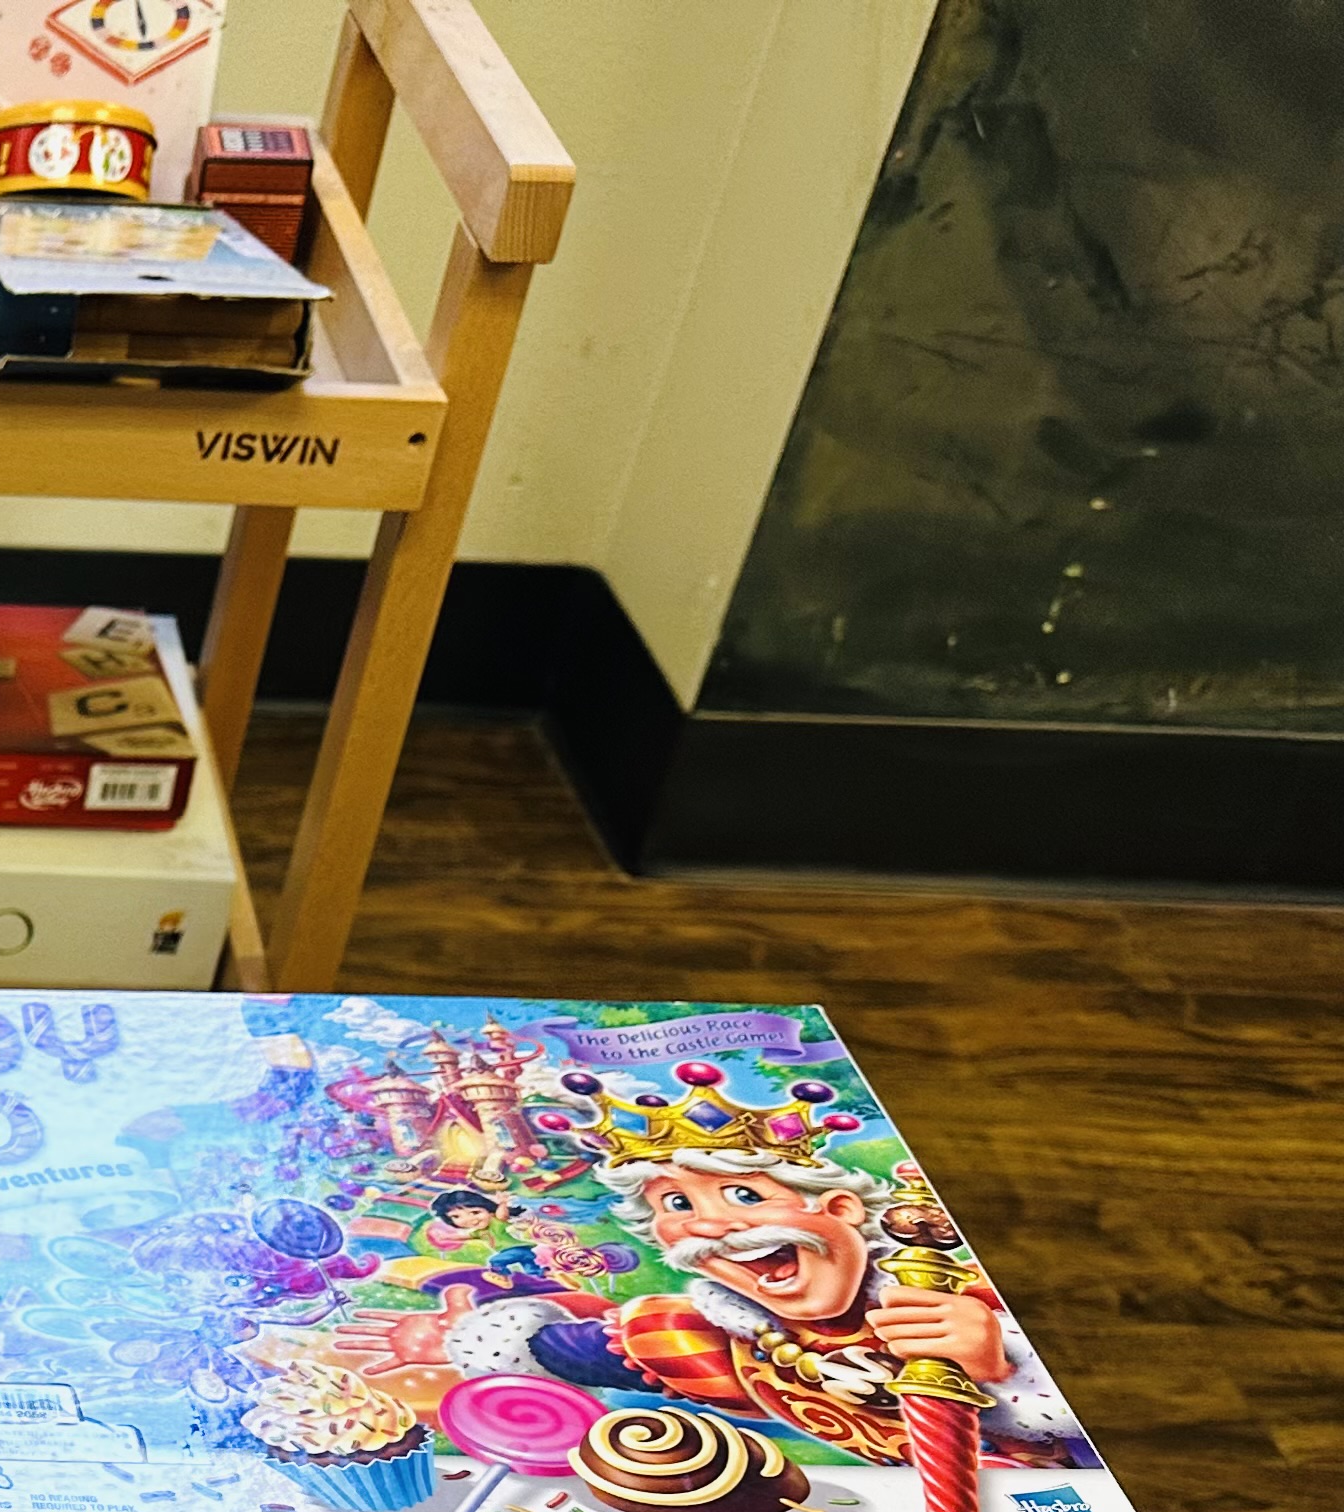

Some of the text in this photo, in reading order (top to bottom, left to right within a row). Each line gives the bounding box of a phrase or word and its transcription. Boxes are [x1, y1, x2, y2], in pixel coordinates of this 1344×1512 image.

[196, 432, 342, 466] VISWIN
[577, 1018, 752, 1046] The Delicious Race
[600, 1050, 622, 1061] to
[628, 1045, 661, 1059] the
[666, 1034, 722, 1053] Castle
